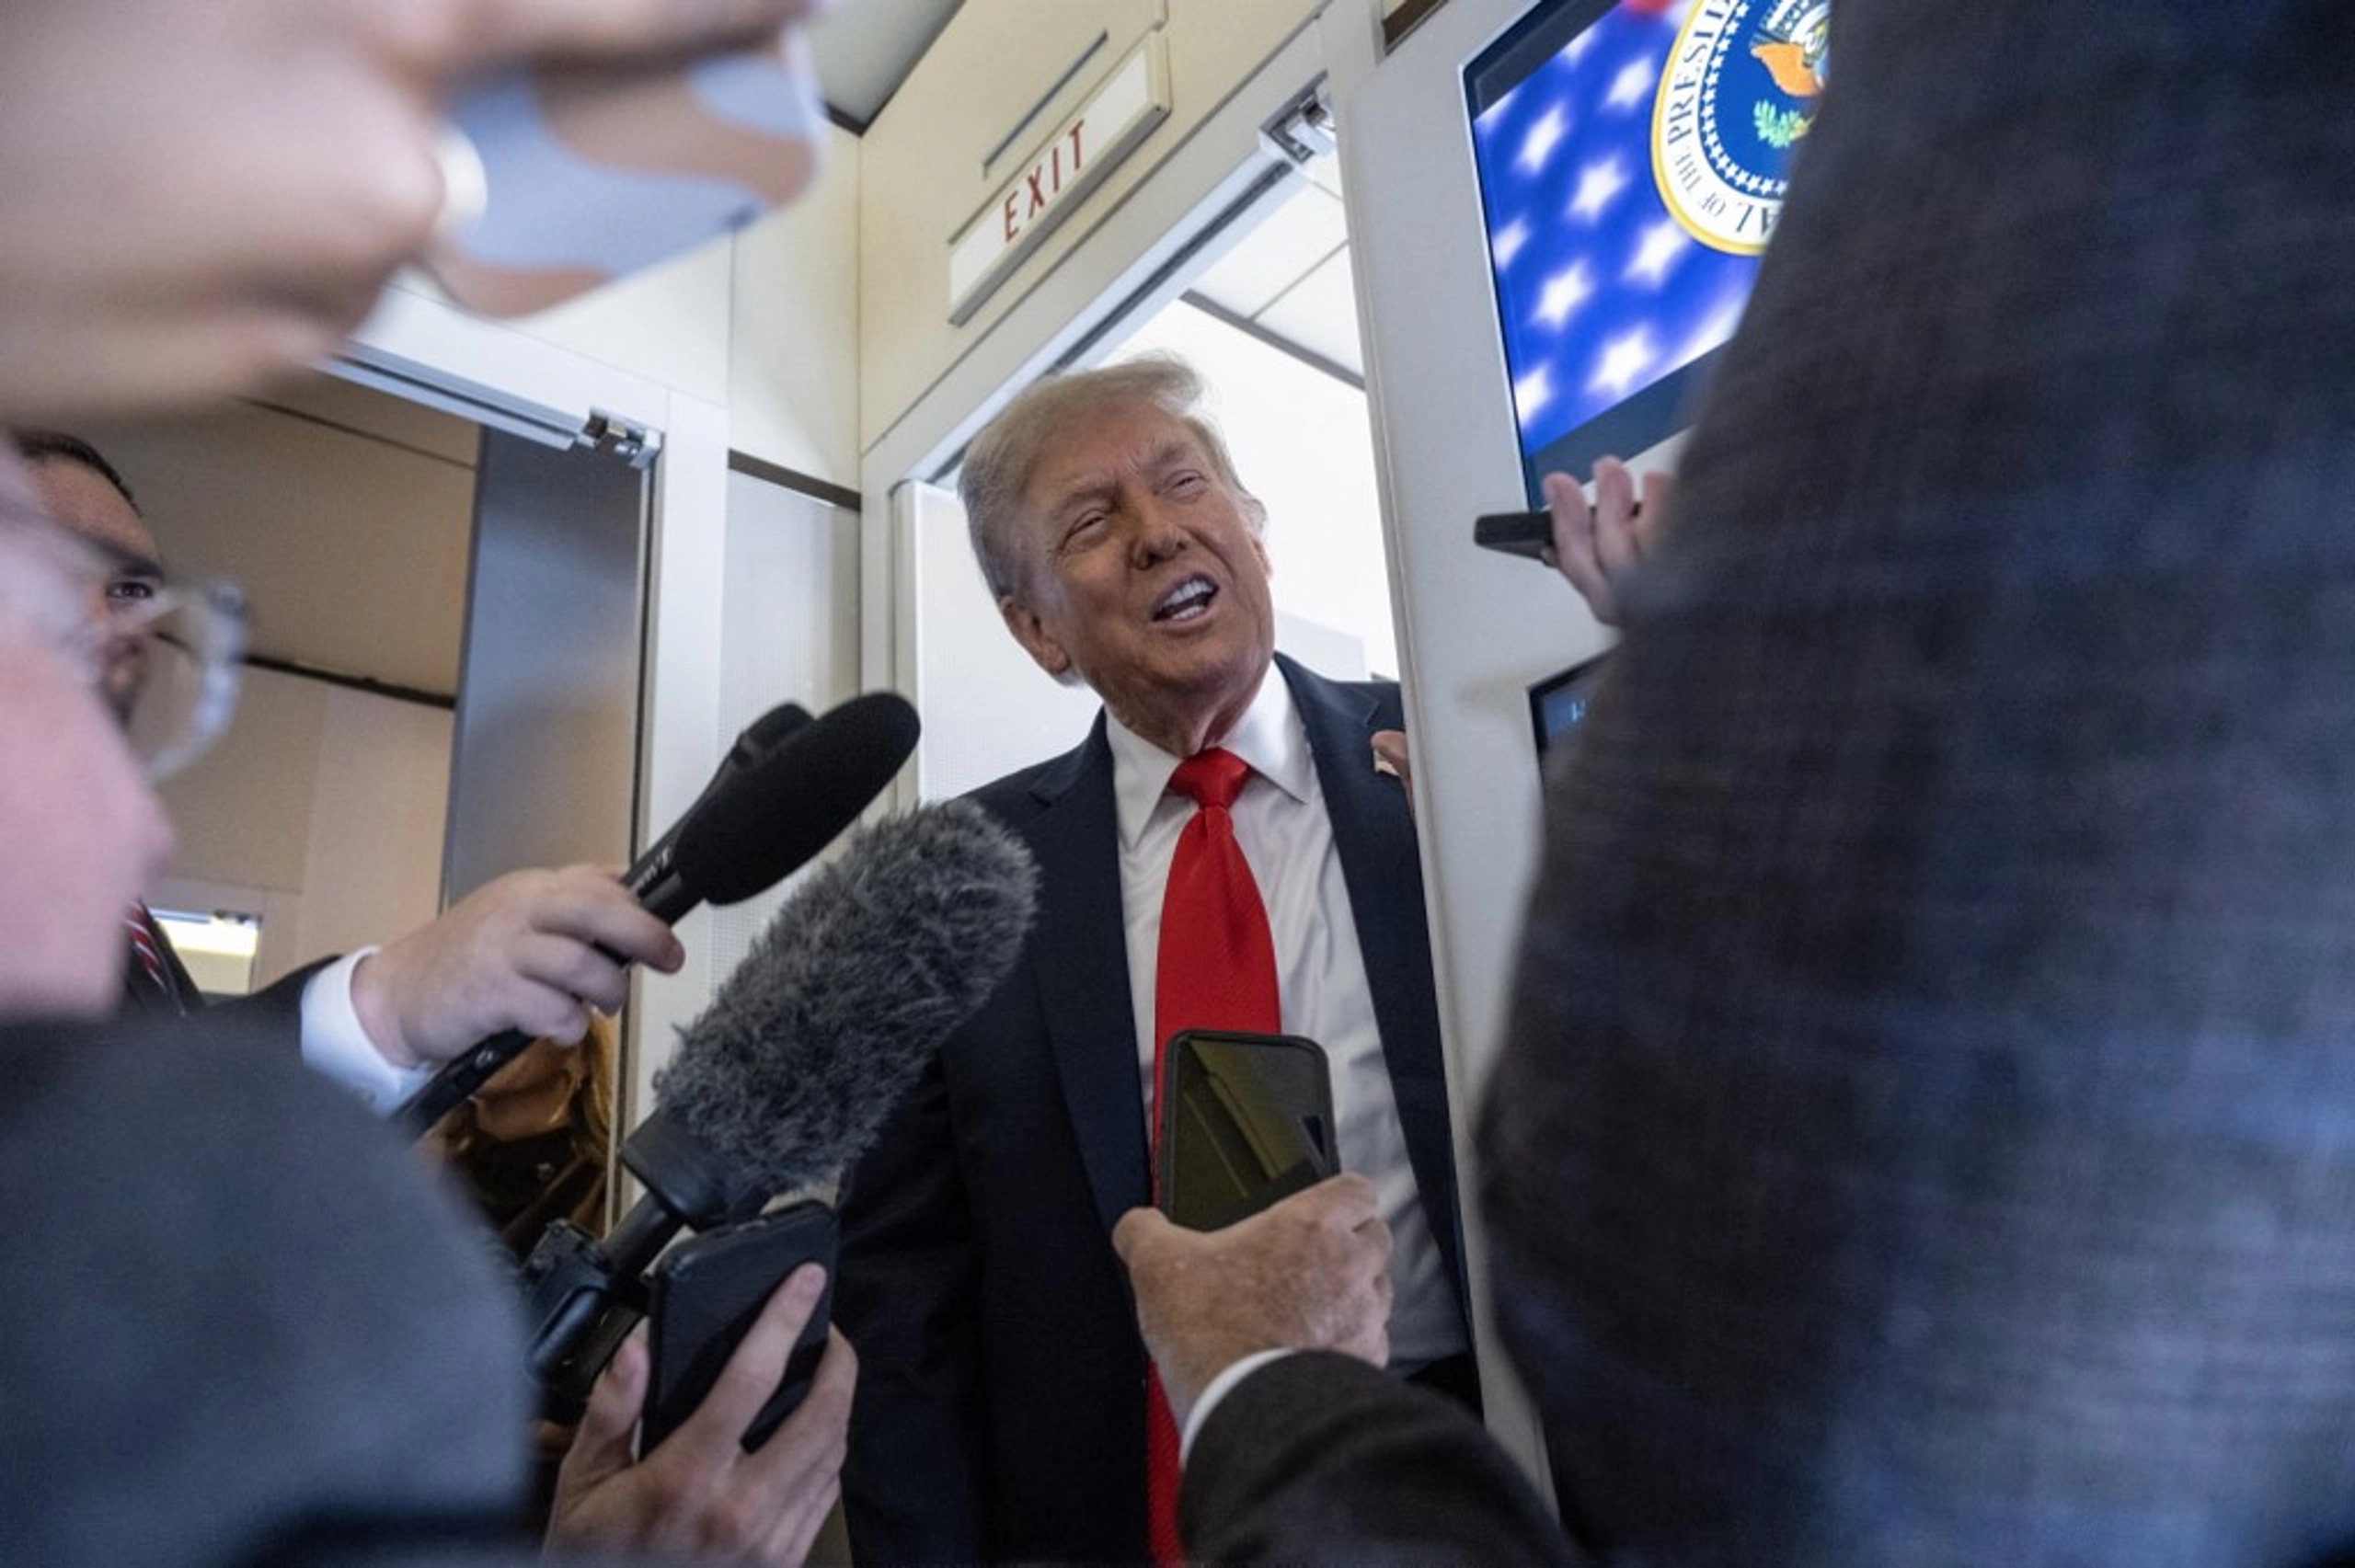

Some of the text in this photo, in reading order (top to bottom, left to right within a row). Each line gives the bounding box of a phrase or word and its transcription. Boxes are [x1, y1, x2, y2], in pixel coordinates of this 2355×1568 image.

[1004, 120, 1085, 242] EXIT
[1675, 153, 1702, 192] THE
[1701, 192, 1727, 216] OF
